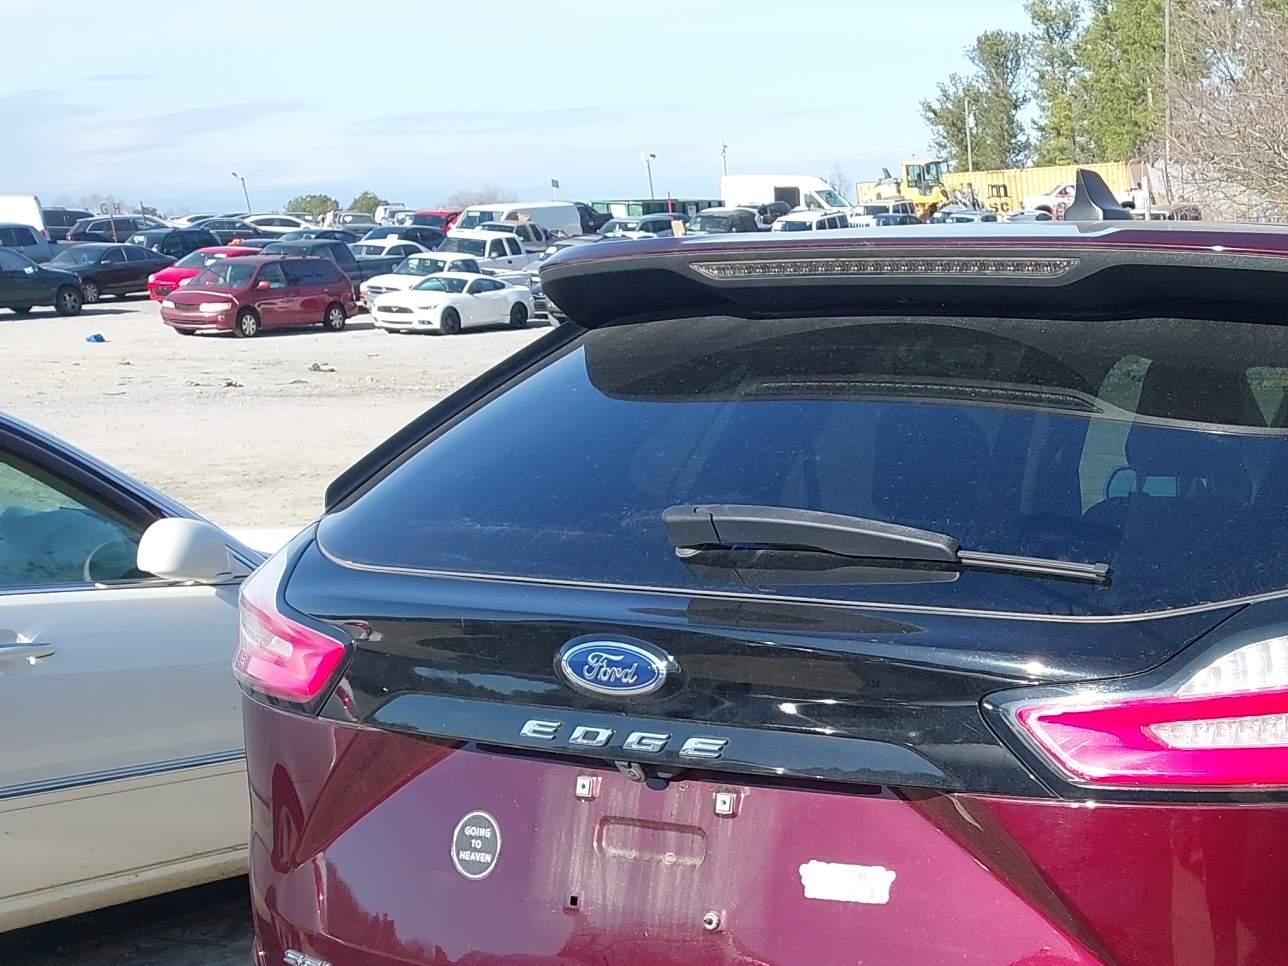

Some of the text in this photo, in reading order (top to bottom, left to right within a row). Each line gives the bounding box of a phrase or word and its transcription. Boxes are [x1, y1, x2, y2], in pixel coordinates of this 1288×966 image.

[582, 651, 639, 684] Ford
[519, 718, 729, 760] EDGE
[464, 826, 491, 838] GOING
[471, 839, 482, 849] TO
[459, 850, 492, 863] HEAVEN
